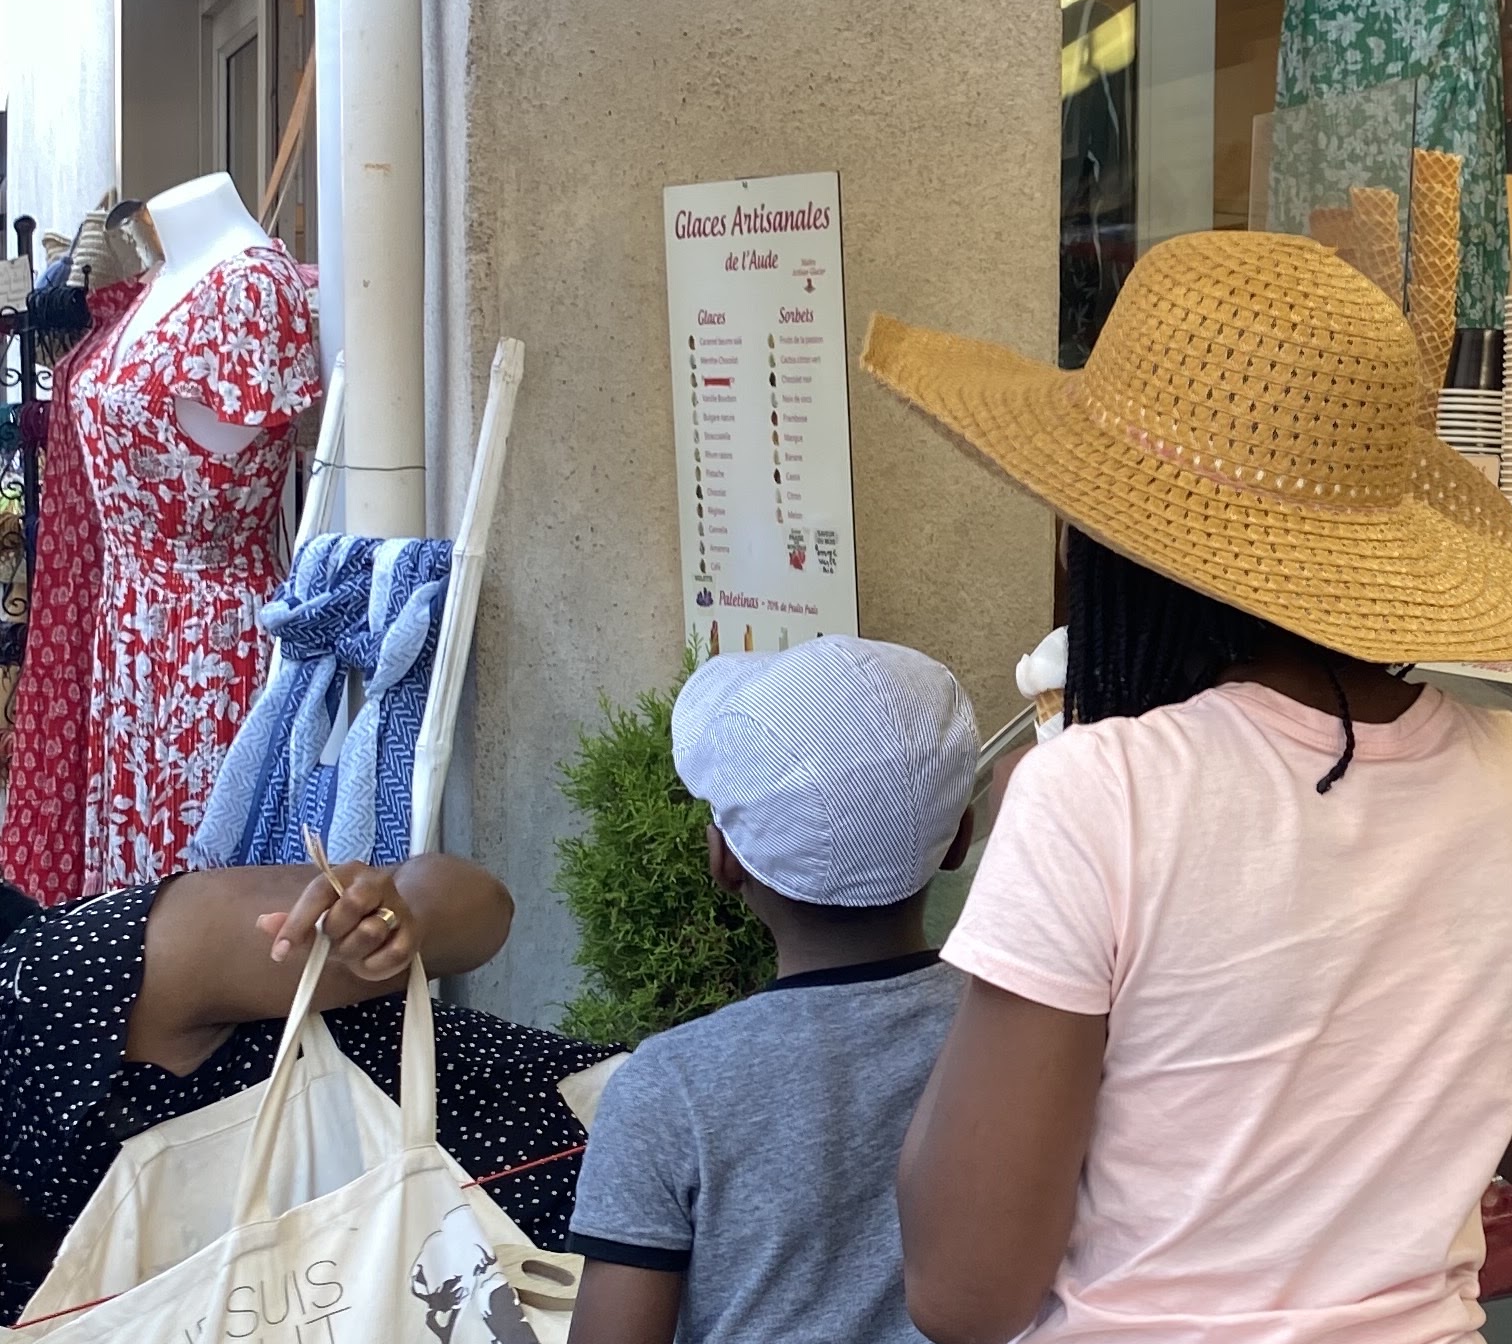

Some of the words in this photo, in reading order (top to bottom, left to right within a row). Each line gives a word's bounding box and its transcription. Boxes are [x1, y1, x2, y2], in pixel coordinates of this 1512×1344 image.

[675, 210, 727, 239] Glaces
[731, 201, 831, 236] Artisanales
[725, 252, 739, 272] de
[697, 309, 726, 326] Glaces
[778, 307, 814, 325] Sorbets
[719, 590, 759, 610] Paletinas
[226, 1260, 344, 1339] SUIS
